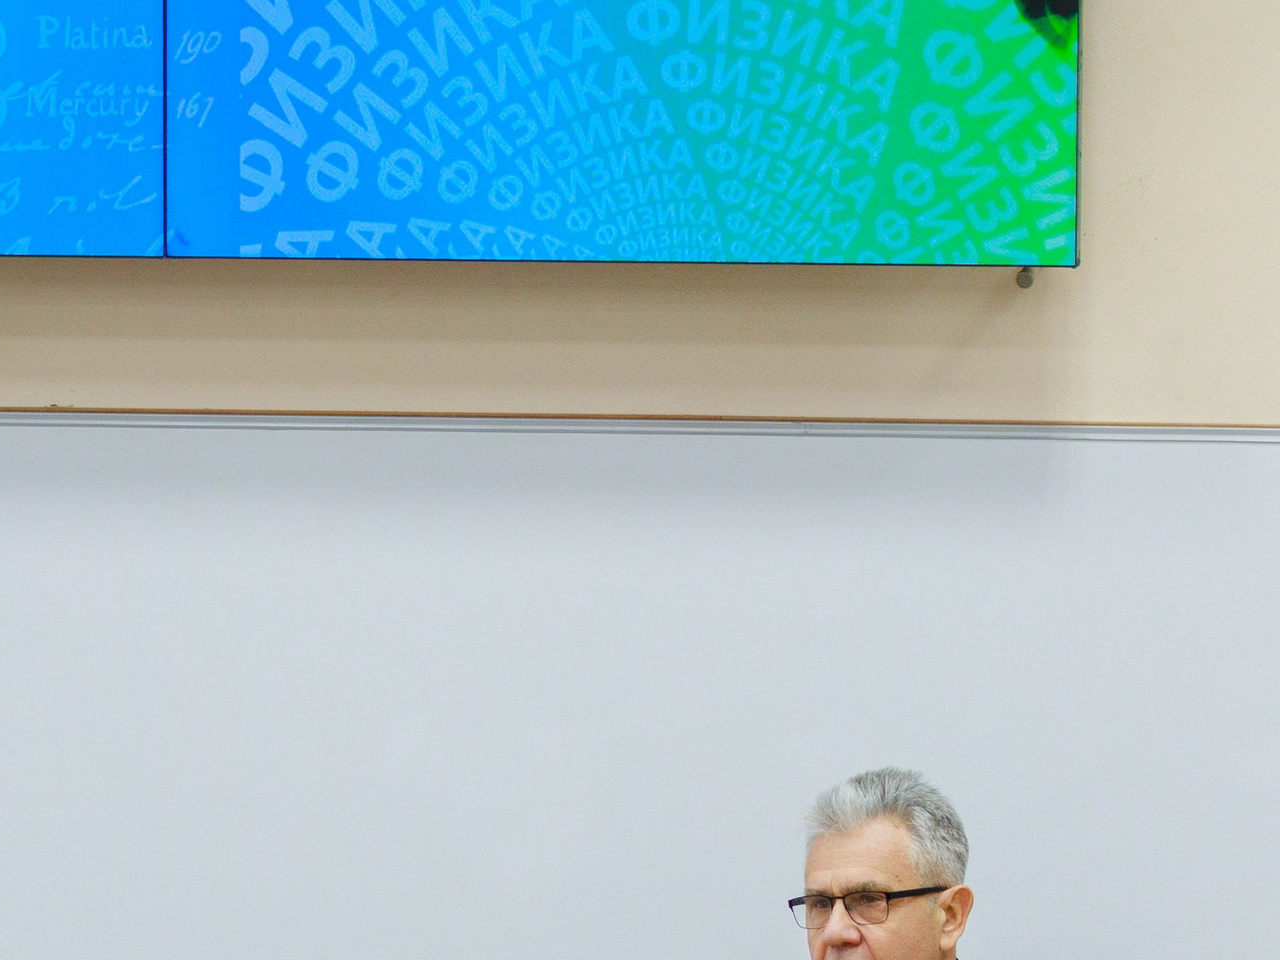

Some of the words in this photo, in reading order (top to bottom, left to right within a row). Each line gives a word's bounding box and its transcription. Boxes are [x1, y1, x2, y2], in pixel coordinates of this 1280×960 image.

[35, 15, 153, 50] Platina
[173, 30, 224, 65] 190
[24, 84, 150, 128] Mercury
[306, 0, 534, 203] ФИЗИК
[376, 7, 615, 201] ФИЗИКА
[436, 55, 650, 204] ФИЗИКА
[488, 98, 676, 211] ФИЗИКА
[661, 49, 891, 168] ФИЗИКА
[687, 98, 876, 214] ФИЗИКА
[530, 138, 695, 221] ФИЗИКА
[566, 172, 708, 232] ФИЗИКА
[595, 202, 718, 246] ФИЗИКА
[705, 141, 862, 252] ФИЗИКА
